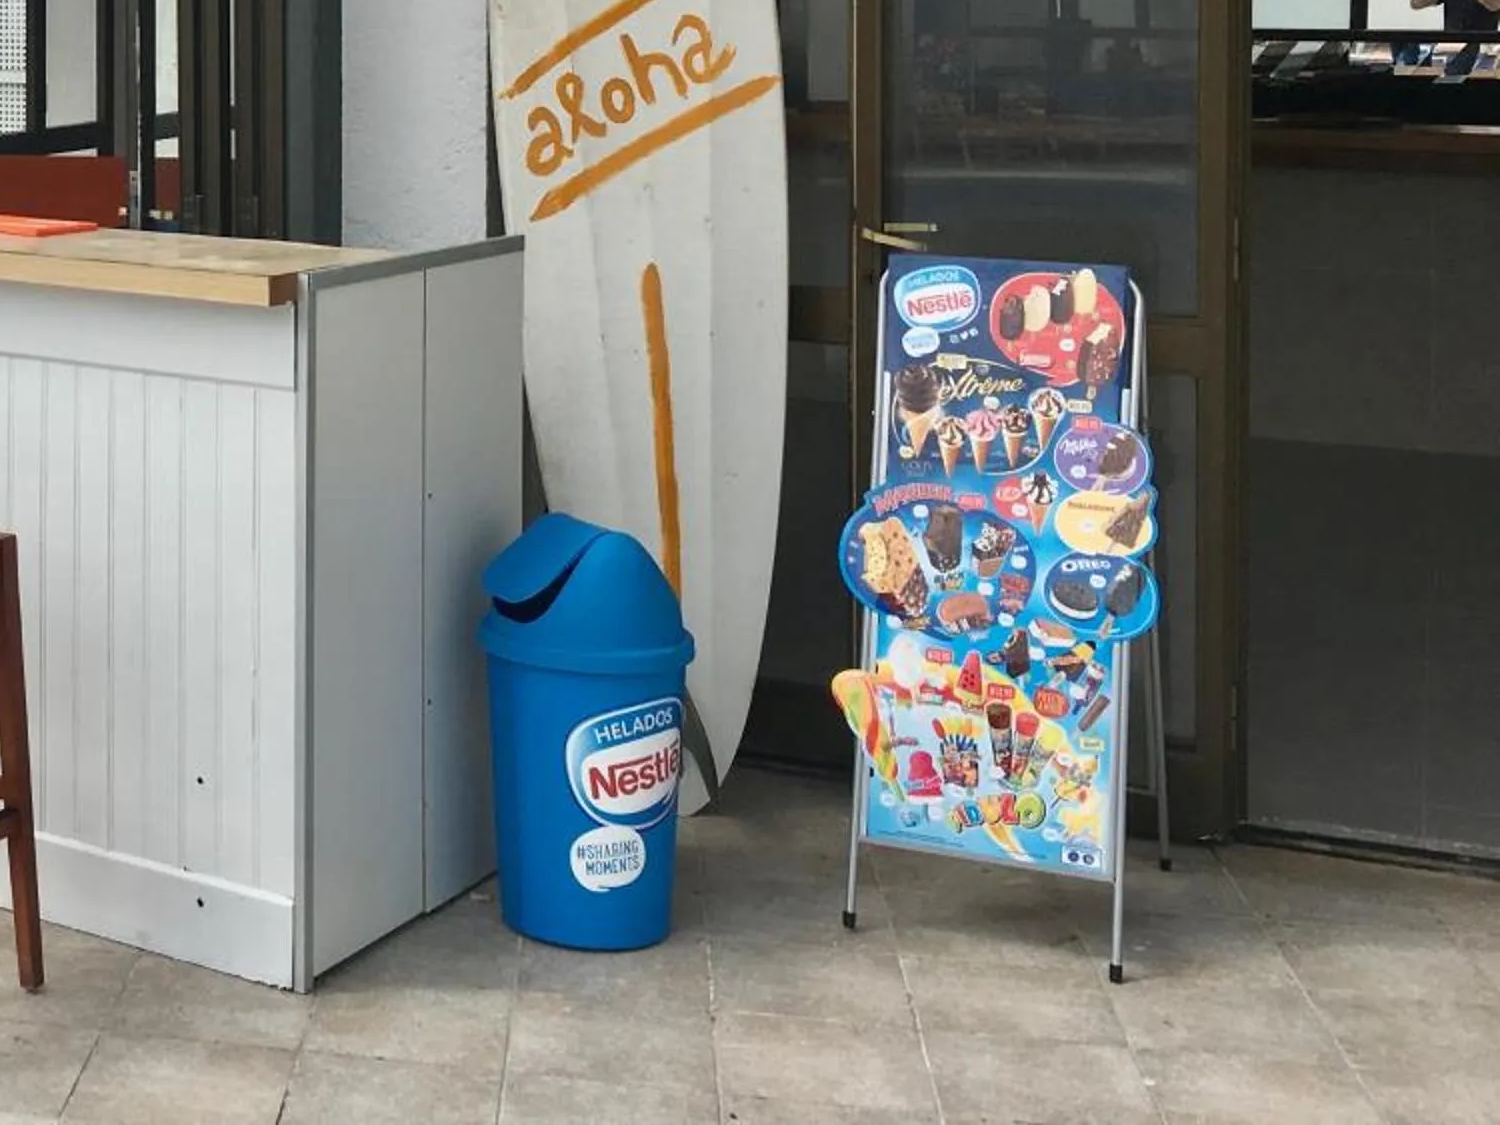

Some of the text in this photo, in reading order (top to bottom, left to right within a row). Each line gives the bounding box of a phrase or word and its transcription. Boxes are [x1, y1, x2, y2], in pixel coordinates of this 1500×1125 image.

[525, 13, 738, 177] aloha
[594, 707, 674, 745] HELADOS
[577, 838, 640, 861] #SHARING
[585, 855, 641, 876] MOMENTS
